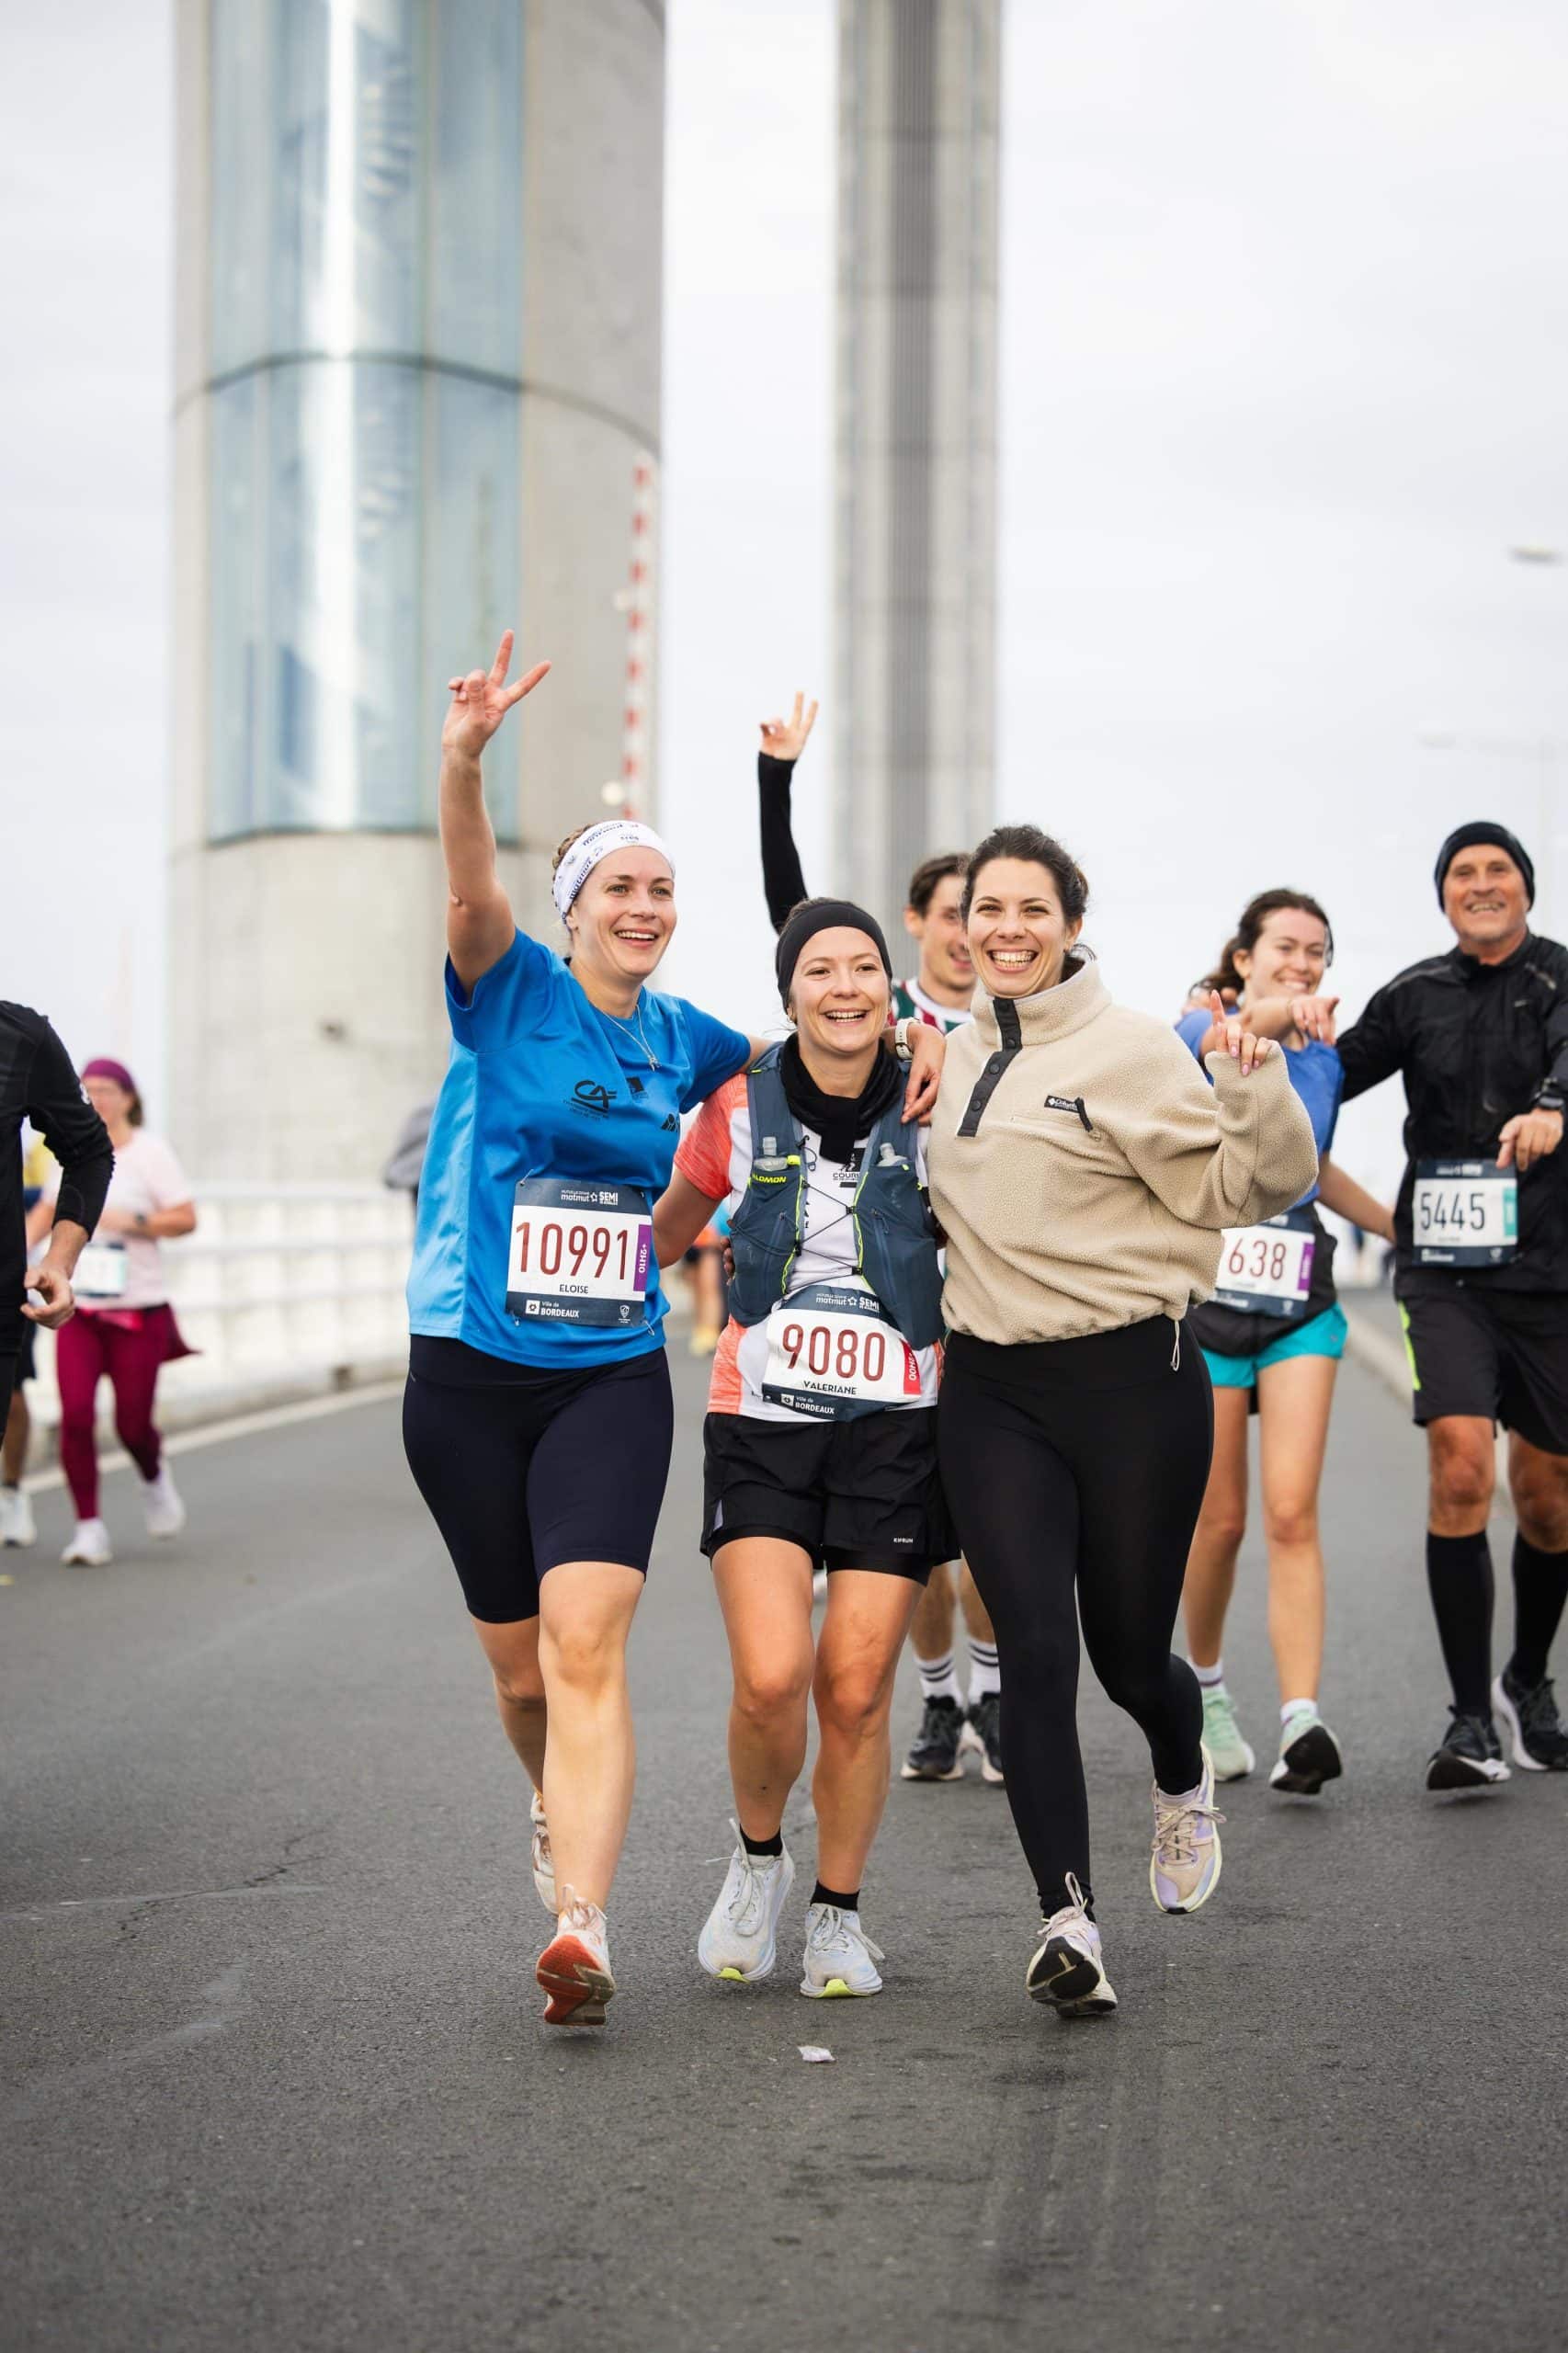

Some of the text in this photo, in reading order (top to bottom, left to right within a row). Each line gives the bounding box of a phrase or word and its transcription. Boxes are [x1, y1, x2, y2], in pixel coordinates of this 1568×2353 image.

[561, 1194, 589, 1202] matmut
[599, 1191, 619, 1202] SEMI
[1420, 1192, 1485, 1231] 5445
[516, 1222, 628, 1280] 10991
[1221, 1237, 1287, 1280] 638
[559, 1284, 589, 1294] ELOISE
[816, 1297, 847, 1305] matmut
[859, 1297, 880, 1310] SEMI
[540, 1308, 579, 1318] BORDEAUX
[782, 1324, 885, 1381] 9080
[803, 1381, 858, 1395] VALERIANE
[794, 1403, 835, 1415] BORDEAUX
